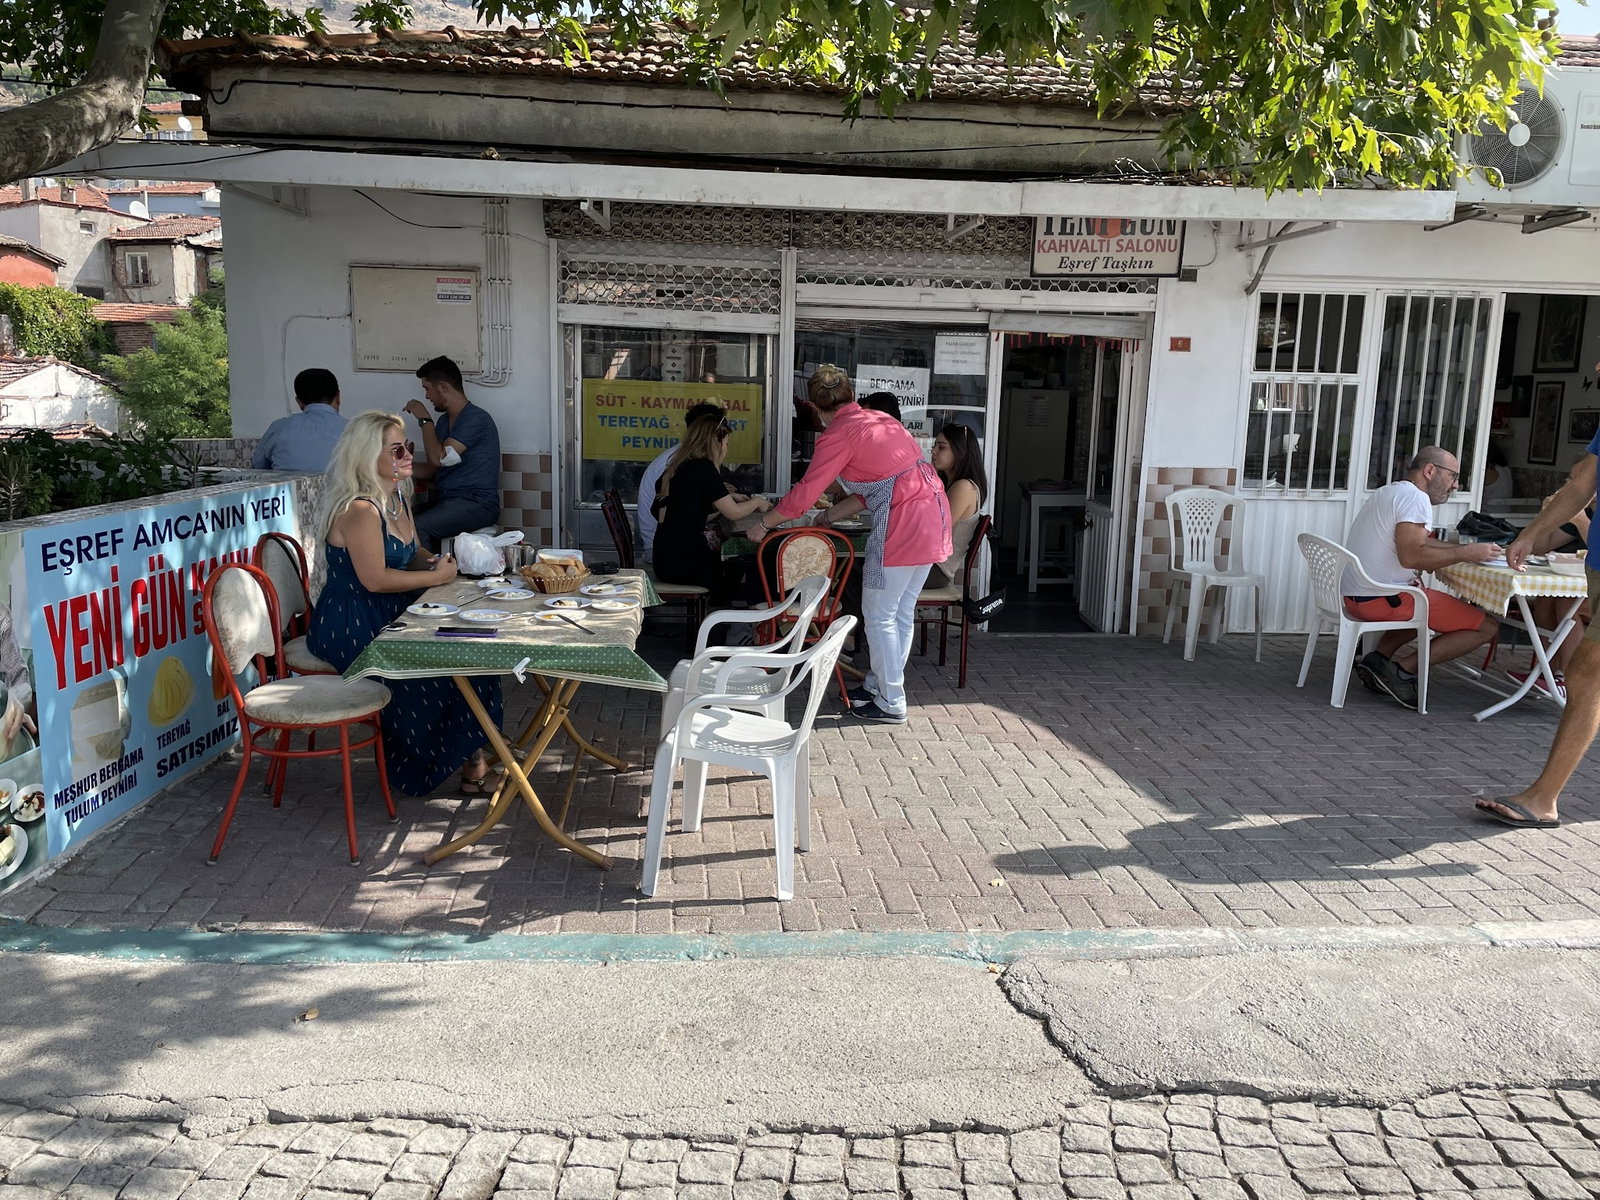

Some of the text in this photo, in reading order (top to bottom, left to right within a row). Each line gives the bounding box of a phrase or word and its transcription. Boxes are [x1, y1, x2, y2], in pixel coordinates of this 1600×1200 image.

[1037, 239, 1179, 253] KAHVALTI SALONU
[1058, 256, 1154, 272] Eşref Taşkın
[870, 378, 915, 391] BERGAMA
[595, 392, 627, 408] SÜT
[897, 394, 925, 407] EYNİRİ
[598, 414, 670, 429] TEREYAĞ
[621, 434, 680, 449] PEYNİR
[41, 490, 286, 575] EŞREF AMCA'NIN YERİ
[43, 565, 125, 691] YENİ
[131, 553, 187, 658] GÜN
[217, 700, 230, 718] BAL
[156, 719, 191, 751] TEREYAĞ
[156, 715, 240, 778] SATIŞIMIZ
[54, 747, 145, 810] MEŞHUR BERGAMA
[64, 770, 138, 827] TULUM PEYNİRİ
